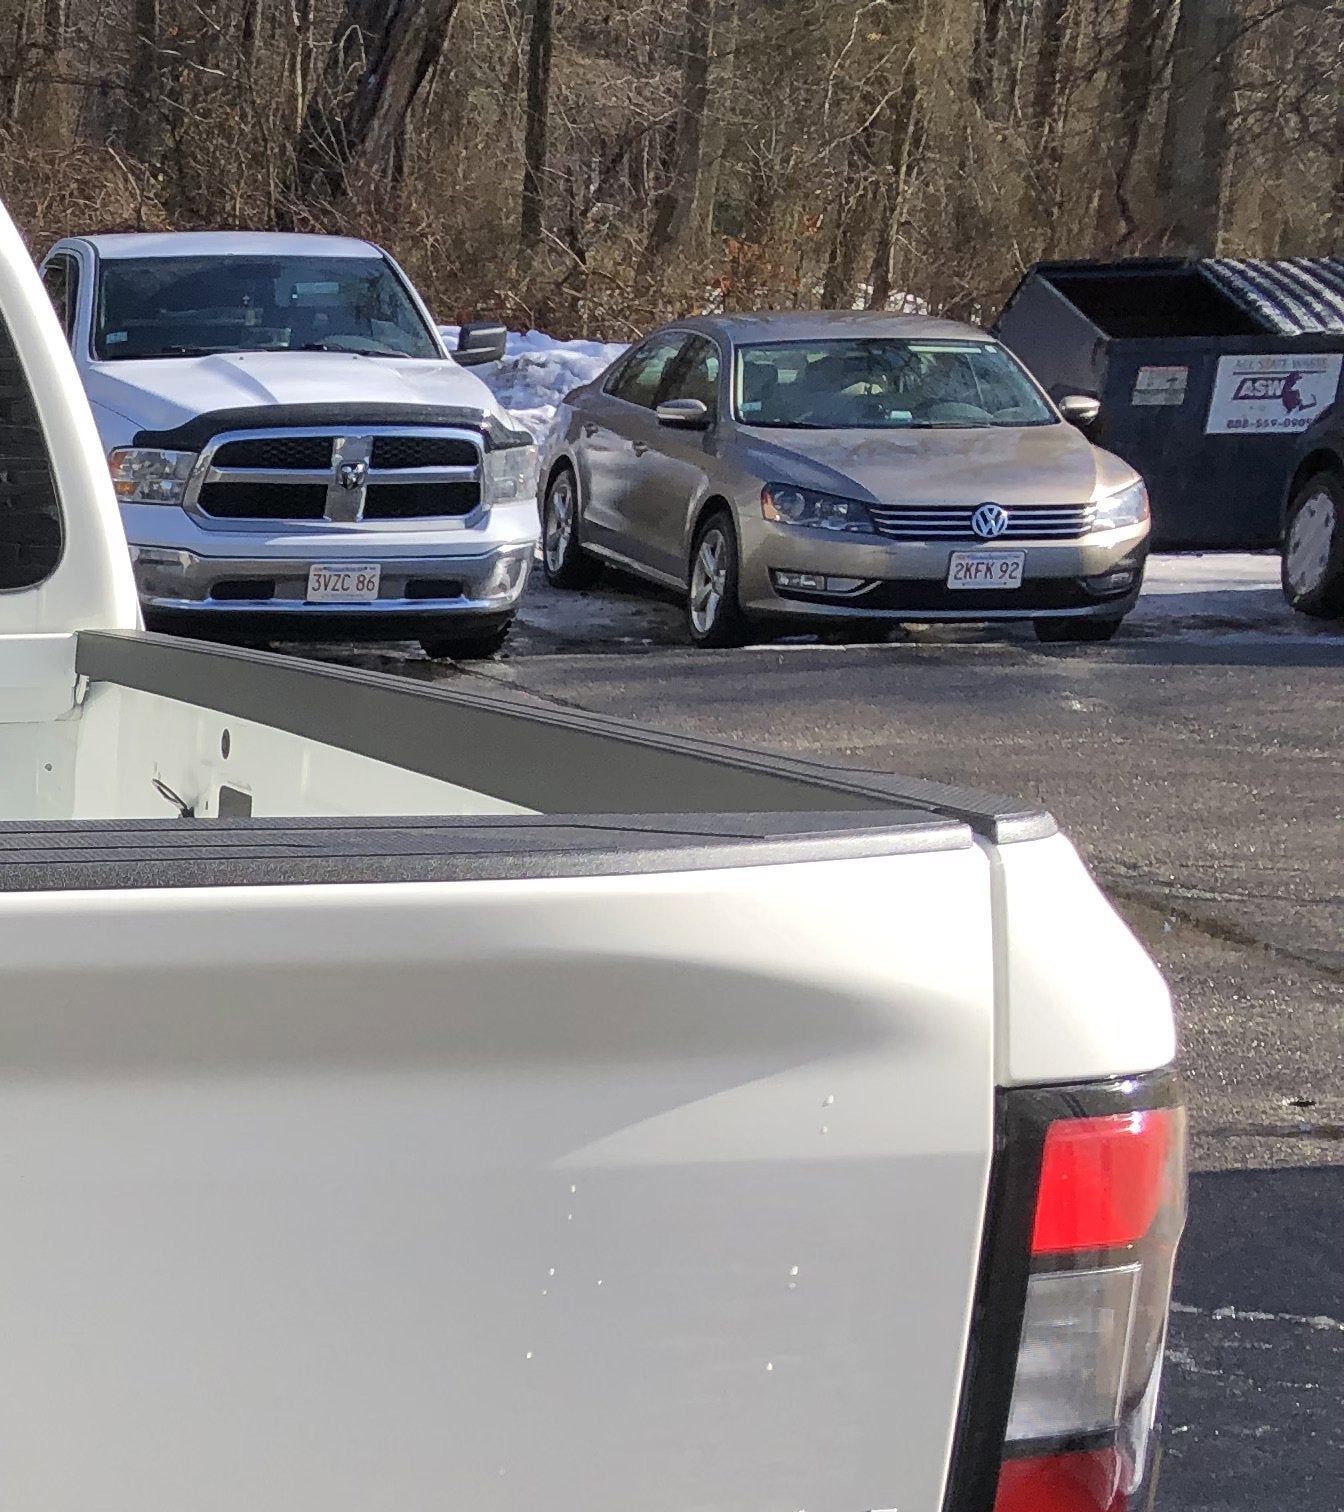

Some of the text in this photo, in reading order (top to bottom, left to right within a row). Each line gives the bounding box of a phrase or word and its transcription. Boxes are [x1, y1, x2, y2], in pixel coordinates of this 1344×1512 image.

[1239, 380, 1285, 397] ASW
[954, 561, 1019, 580] 2KFK 92
[311, 573, 376, 591] 3VZC 86
